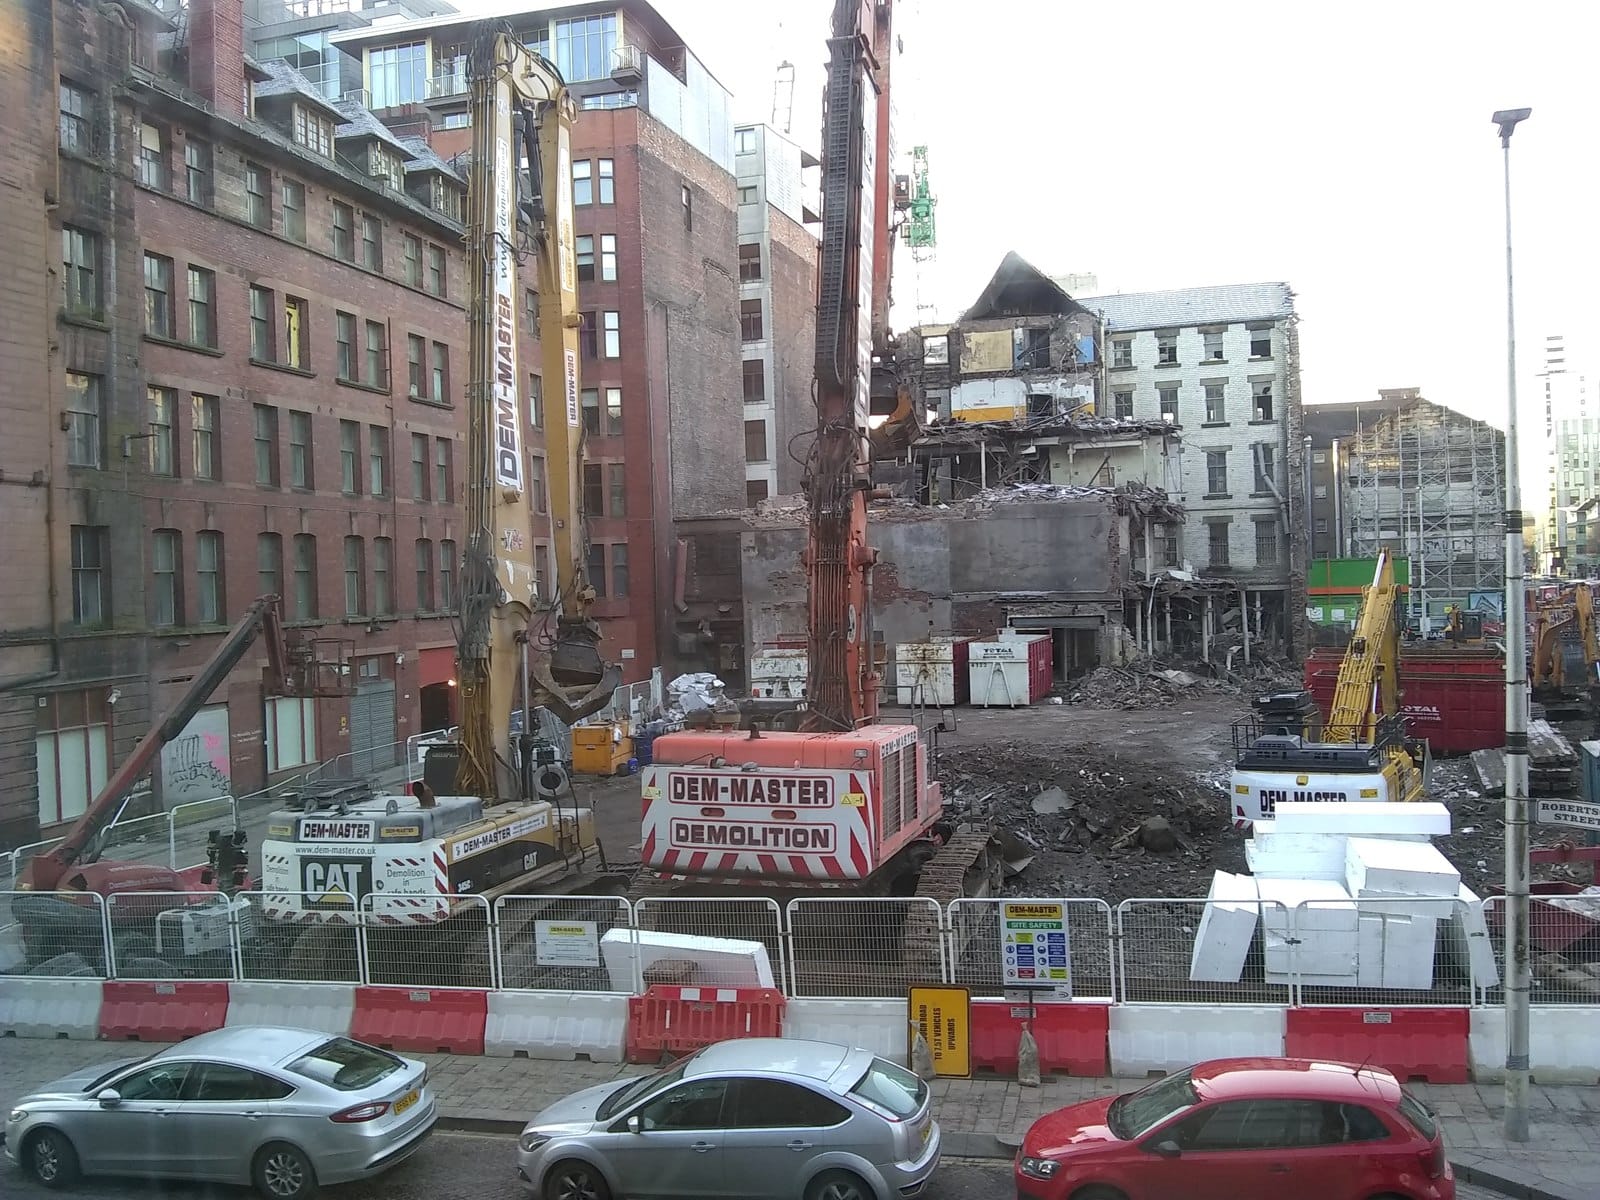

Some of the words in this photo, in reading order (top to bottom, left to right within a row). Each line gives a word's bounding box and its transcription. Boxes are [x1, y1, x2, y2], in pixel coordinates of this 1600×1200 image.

[497, 293, 519, 481] DEM-MASTER
[567, 354, 577, 422] DEM-MASTER
[673, 776, 828, 805] DEM-MASTER
[303, 823, 370, 839] DEM-MASTER
[463, 827, 511, 853] DEM-MASTER
[675, 823, 830, 848] DEMOLITION
[295, 845, 376, 855] www.dem-master.co.uk
[523, 851, 538, 870] CAT
[305, 862, 363, 902] CAT
[386, 868, 426, 877] Demolition
[402, 878, 410, 886] in
[919, 1005, 928, 1022] ROAD
[933, 1008, 942, 1038] VEHICLES
[947, 1018, 956, 1051] UPWARDS
[934, 1052, 943, 1060] TO
